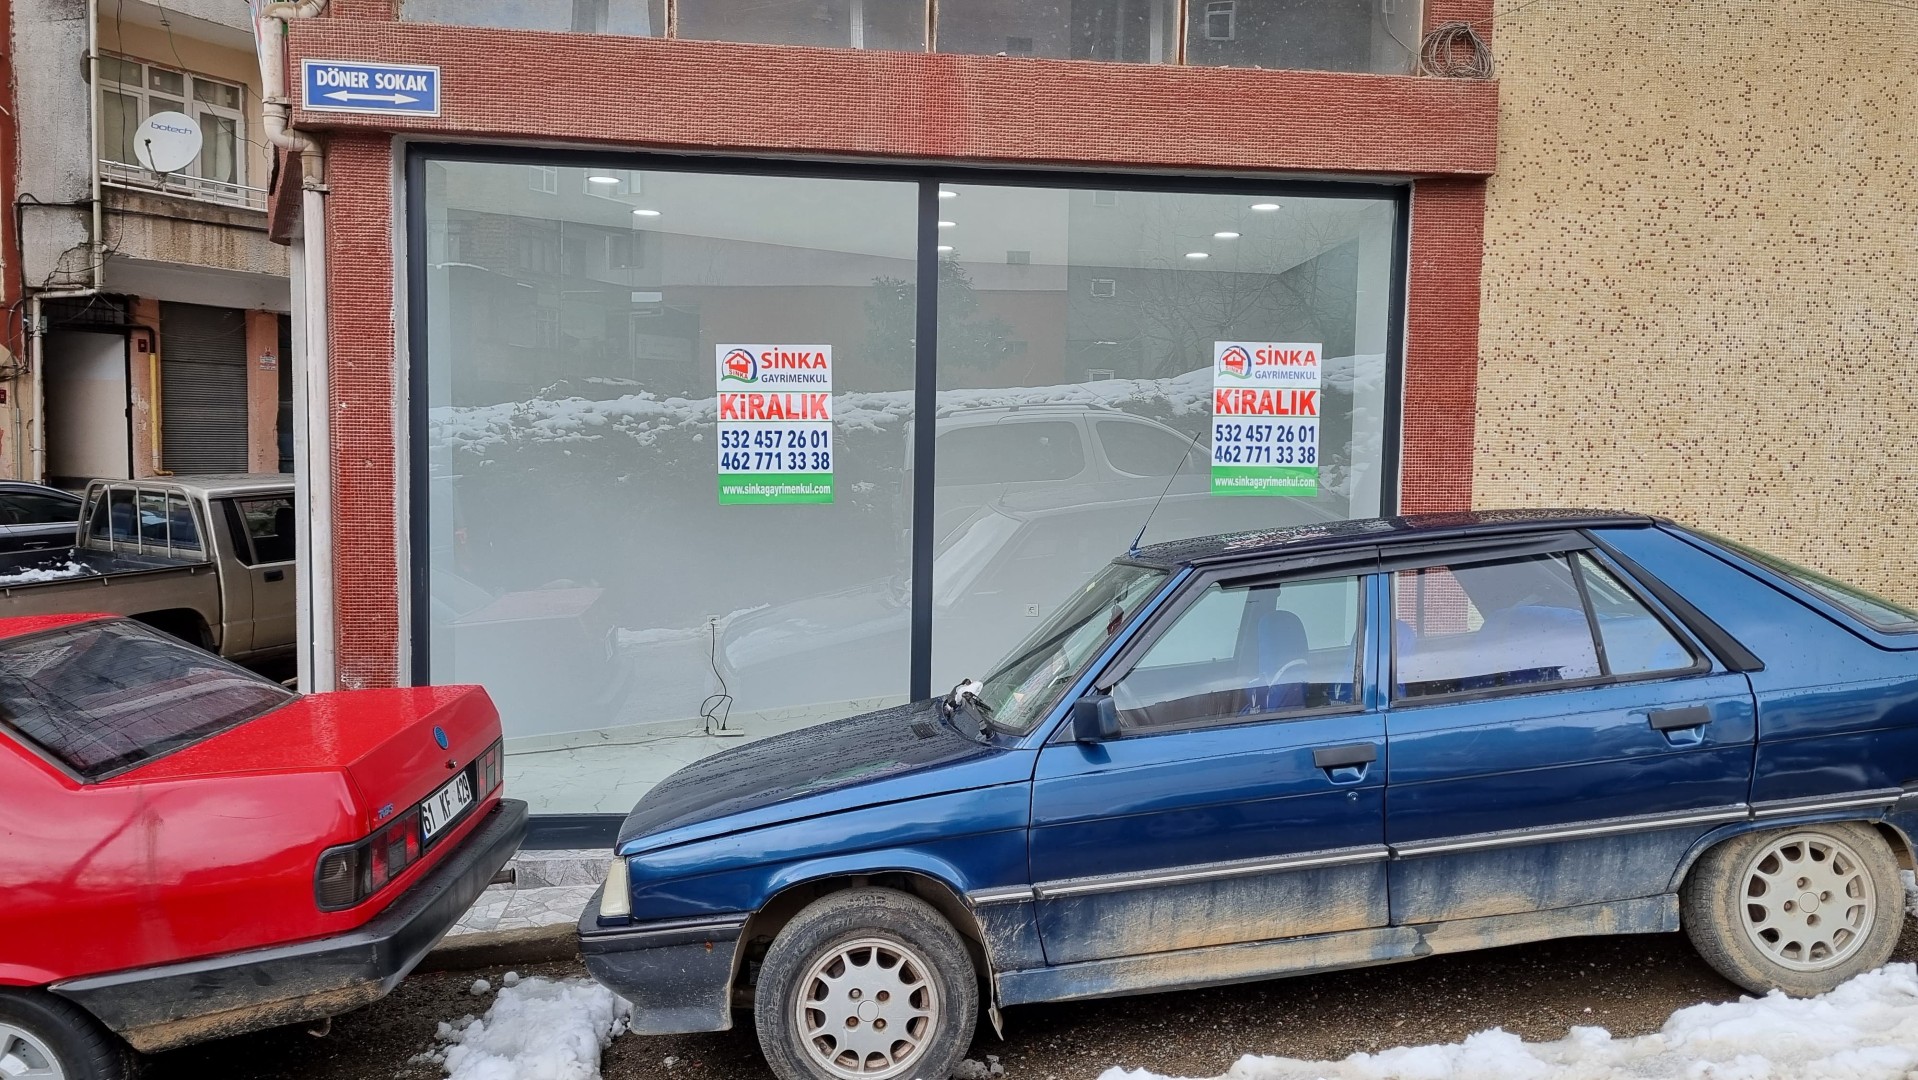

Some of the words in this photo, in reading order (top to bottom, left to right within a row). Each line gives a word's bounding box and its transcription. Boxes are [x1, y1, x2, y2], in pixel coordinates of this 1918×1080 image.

[316, 68, 369, 89] DÖNER
[375, 73, 428, 92] SOKAK
[151, 121, 192, 135] botech
[761, 347, 827, 369] SİNKA
[1255, 344, 1317, 366] SİNKA
[761, 372, 828, 383] GAYRİMENKUL
[1255, 369, 1317, 380] GAYRİMENKUL
[721, 430, 750, 449] 532
[754, 430, 783, 449] 457
[787, 430, 807, 449] 26
[810, 430, 828, 449] 01
[1215, 424, 1242, 442] 532
[1245, 424, 1273, 443] 457
[1276, 425, 1295, 443] 26
[1298, 425, 1315, 443] 01
[721, 451, 750, 470] 462
[754, 451, 782, 470] 771
[787, 451, 807, 470] 33
[811, 451, 830, 470] 38
[1214, 445, 1241, 463] 462
[1245, 446, 1271, 463] 771
[1276, 446, 1294, 464] 33
[1298, 446, 1316, 464] 38
[722, 483, 831, 497] www.sinkagayrimenkul.com
[1215, 475, 1316, 489] www.sinkagayrimenkul.com
[422, 802, 436, 834] 61
[439, 788, 451, 822] KF
[456, 774, 470, 806] 429
